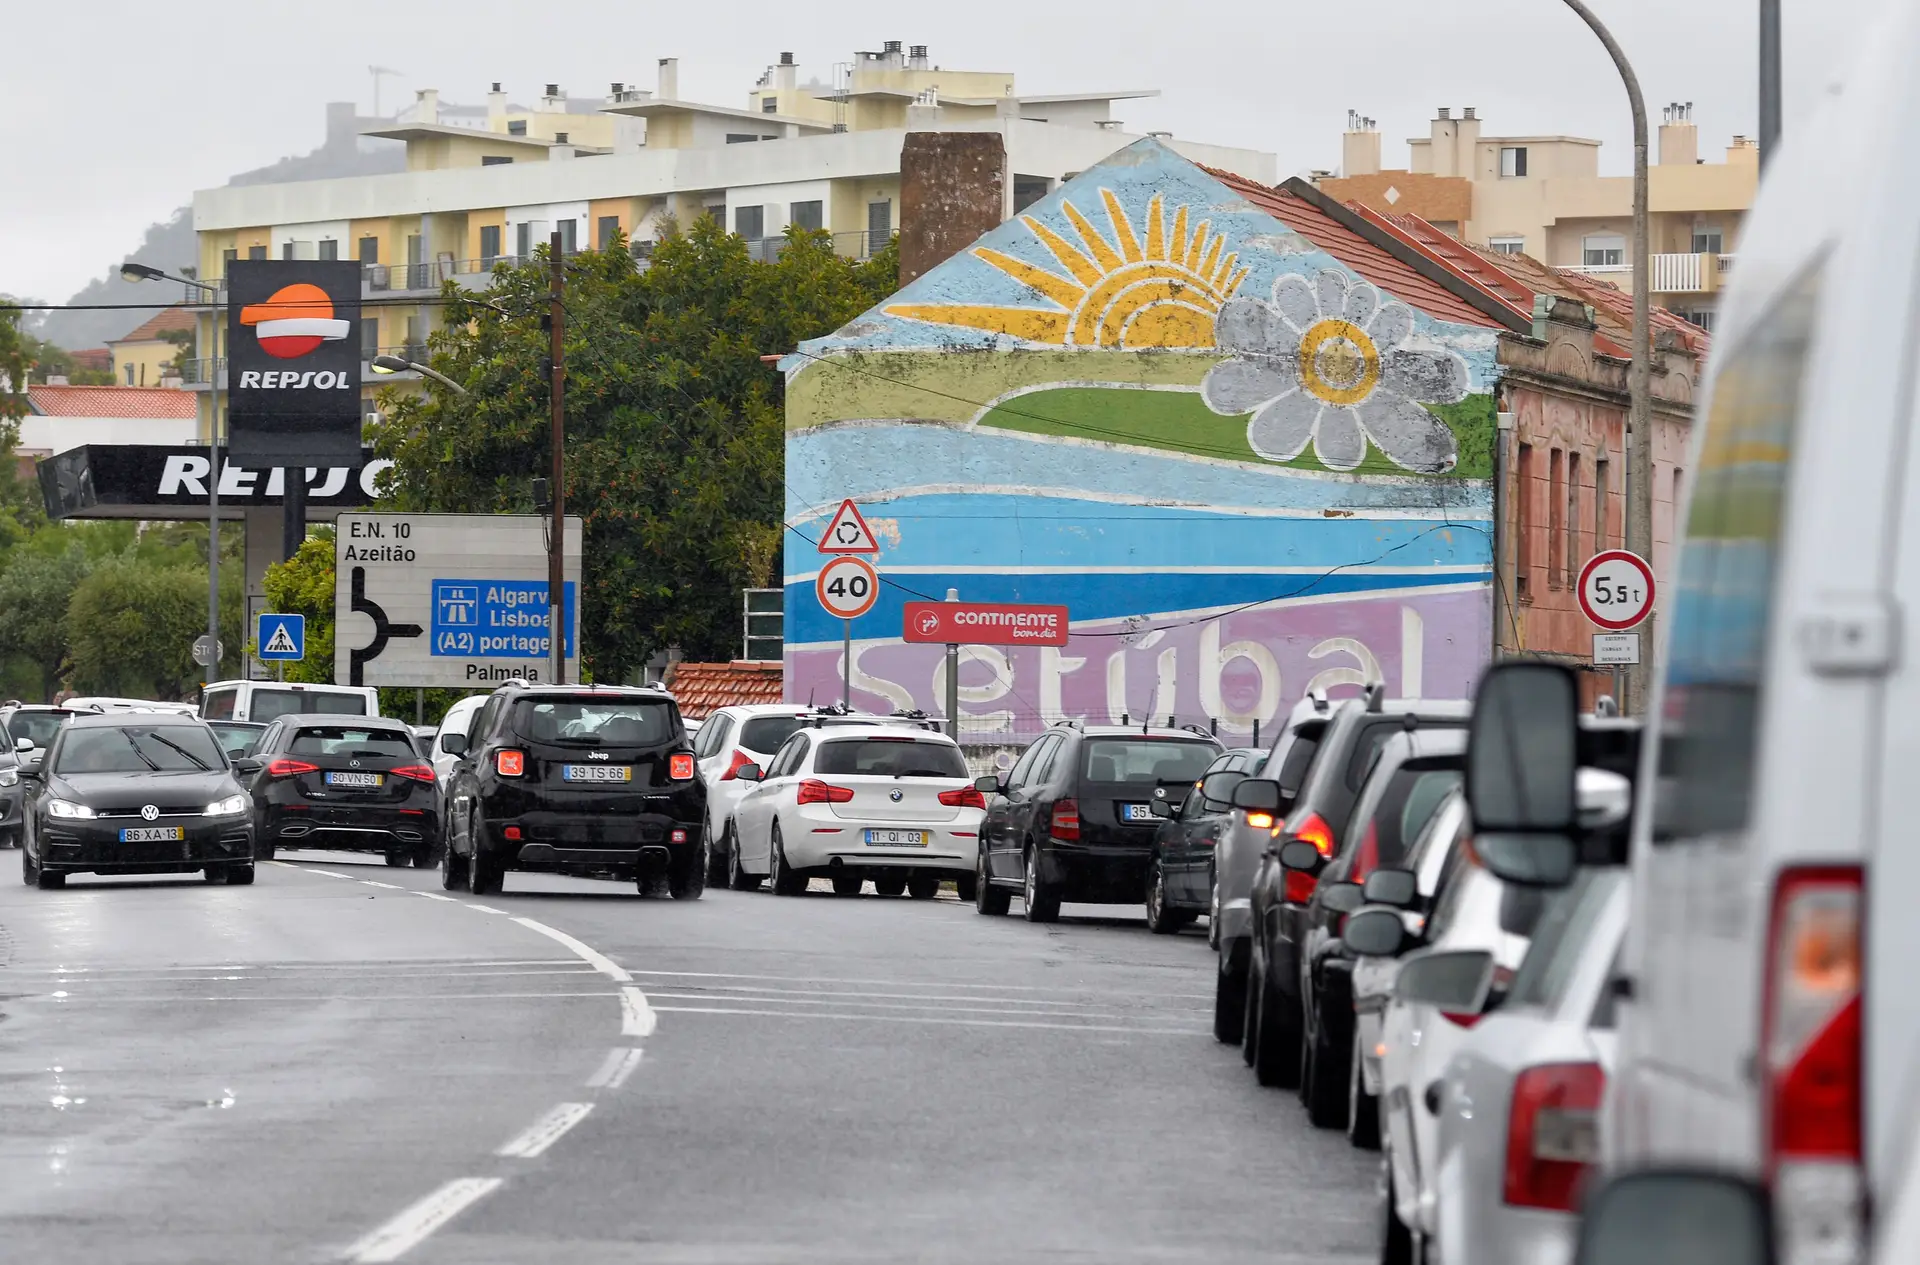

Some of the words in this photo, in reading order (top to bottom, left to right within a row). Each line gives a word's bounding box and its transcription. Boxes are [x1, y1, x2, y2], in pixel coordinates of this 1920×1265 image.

[239, 370, 350, 389] REPSOL
[351, 522, 385, 538] E.N.
[393, 523, 410, 538] 10
[345, 545, 416, 561] Azeitão
[827, 576, 868, 598] 40
[486, 587, 549, 608] Algarv
[954, 611, 1058, 627] CONTINENTE
[438, 633, 474, 653] (A2)
[466, 664, 539, 681] Palmela
[588, 752, 609, 761] Jeep
